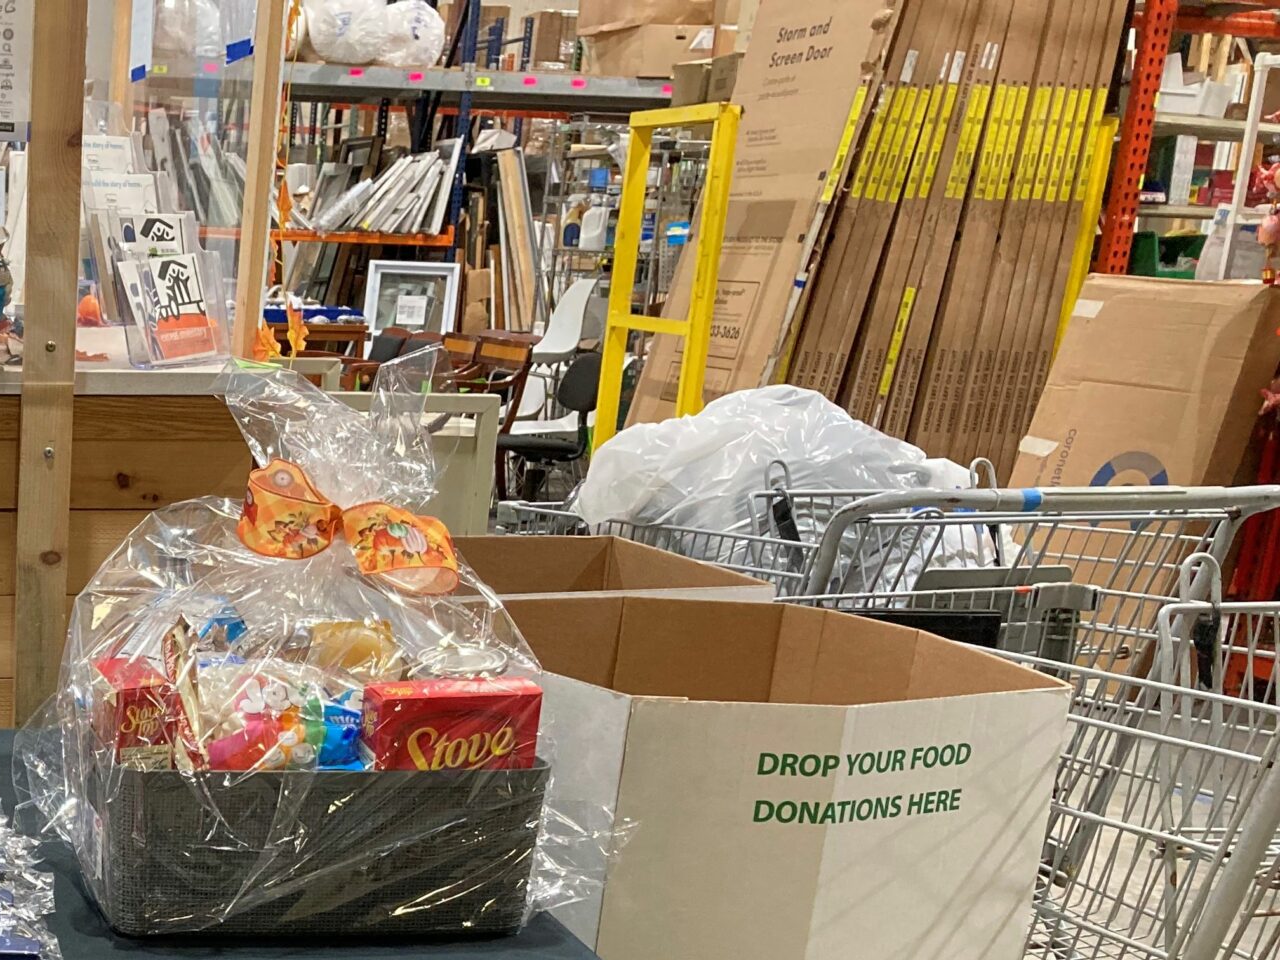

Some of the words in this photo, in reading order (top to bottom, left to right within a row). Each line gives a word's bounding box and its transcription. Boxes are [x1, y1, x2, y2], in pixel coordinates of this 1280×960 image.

[776, 25, 807, 43] Storm
[810, 16, 833, 36] and
[769, 51, 803, 68] Screen
[805, 45, 834, 62] Door
[407, 726, 516, 770] Stove
[757, 752, 840, 777] DROP
[846, 749, 906, 776] YOUR
[910, 743, 971, 770] FOOD
[753, 795, 902, 824] DONATIONS
[906, 788, 962, 816] HERE
